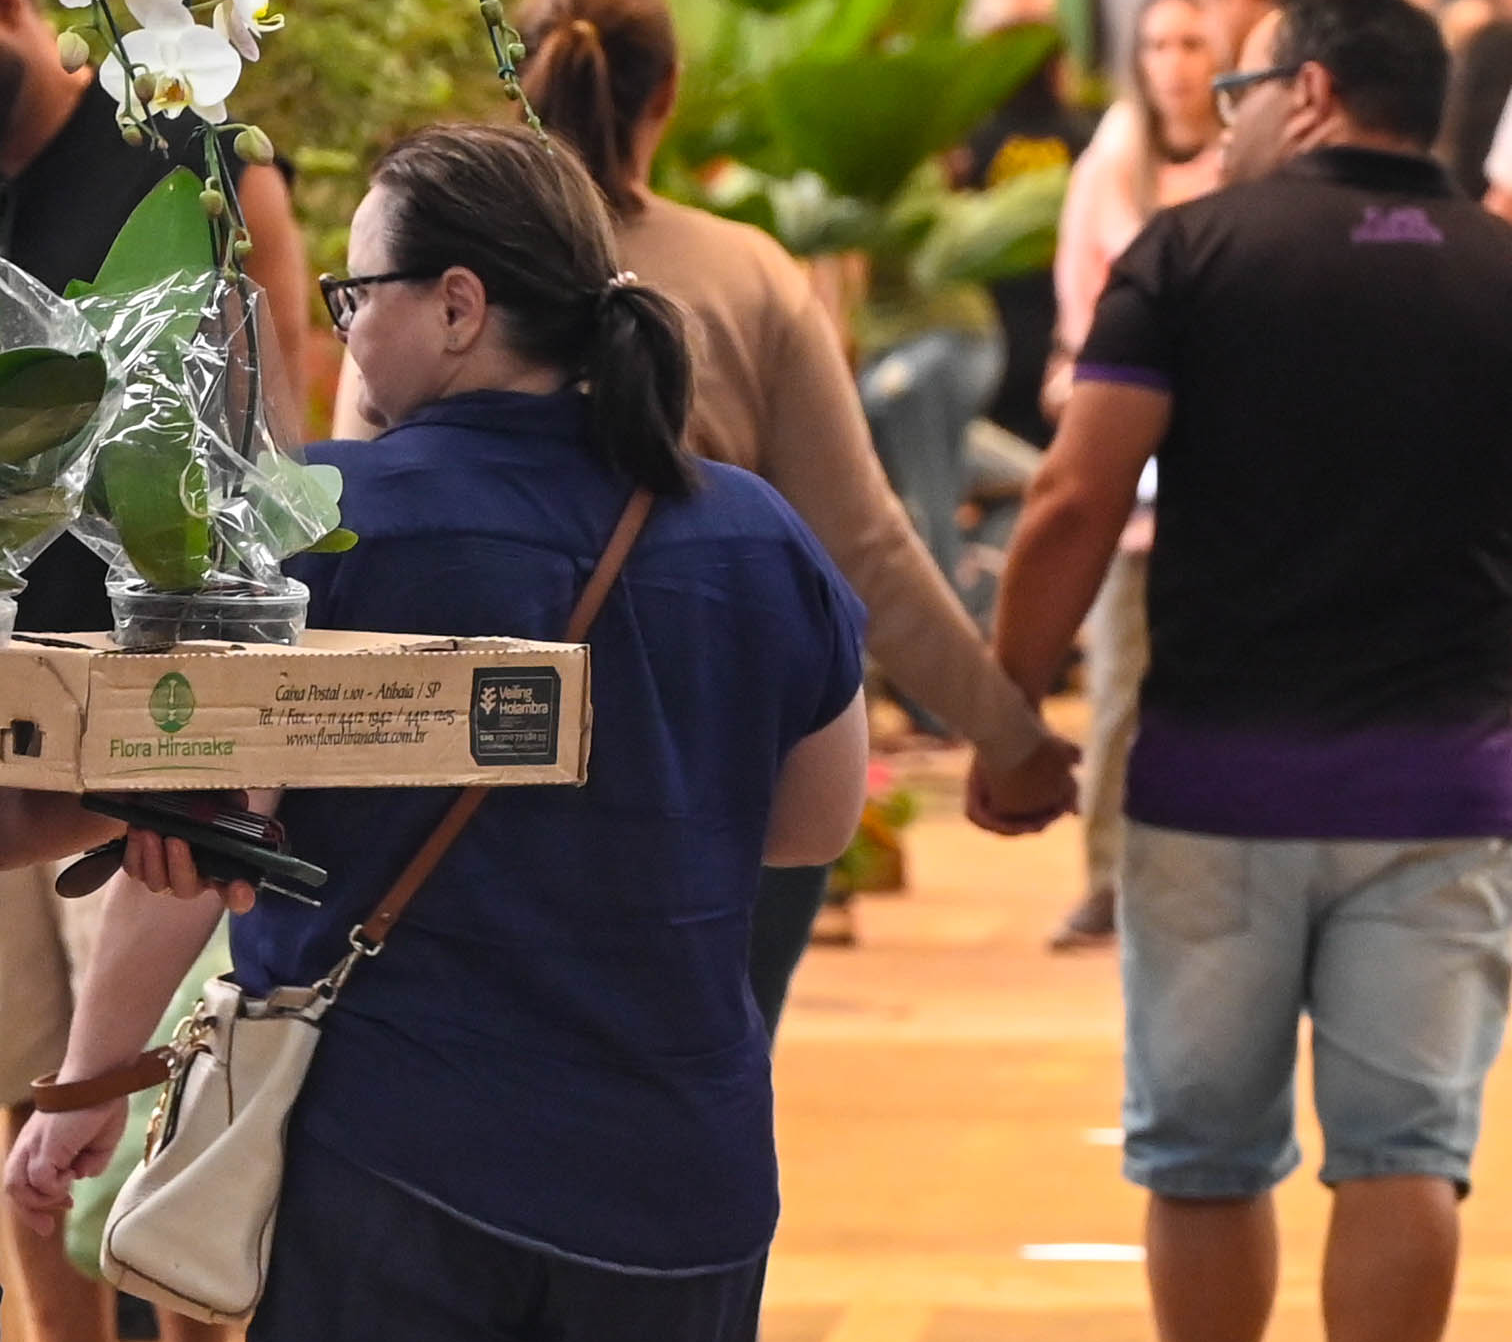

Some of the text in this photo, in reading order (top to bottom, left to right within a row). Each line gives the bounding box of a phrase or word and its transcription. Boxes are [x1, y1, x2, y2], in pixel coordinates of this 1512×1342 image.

[307, 683, 341, 701] Postal
[425, 681, 443, 699] SP
[499, 700, 549, 715] Holambra
[109, 735, 234, 758] Flora Hiranaka
